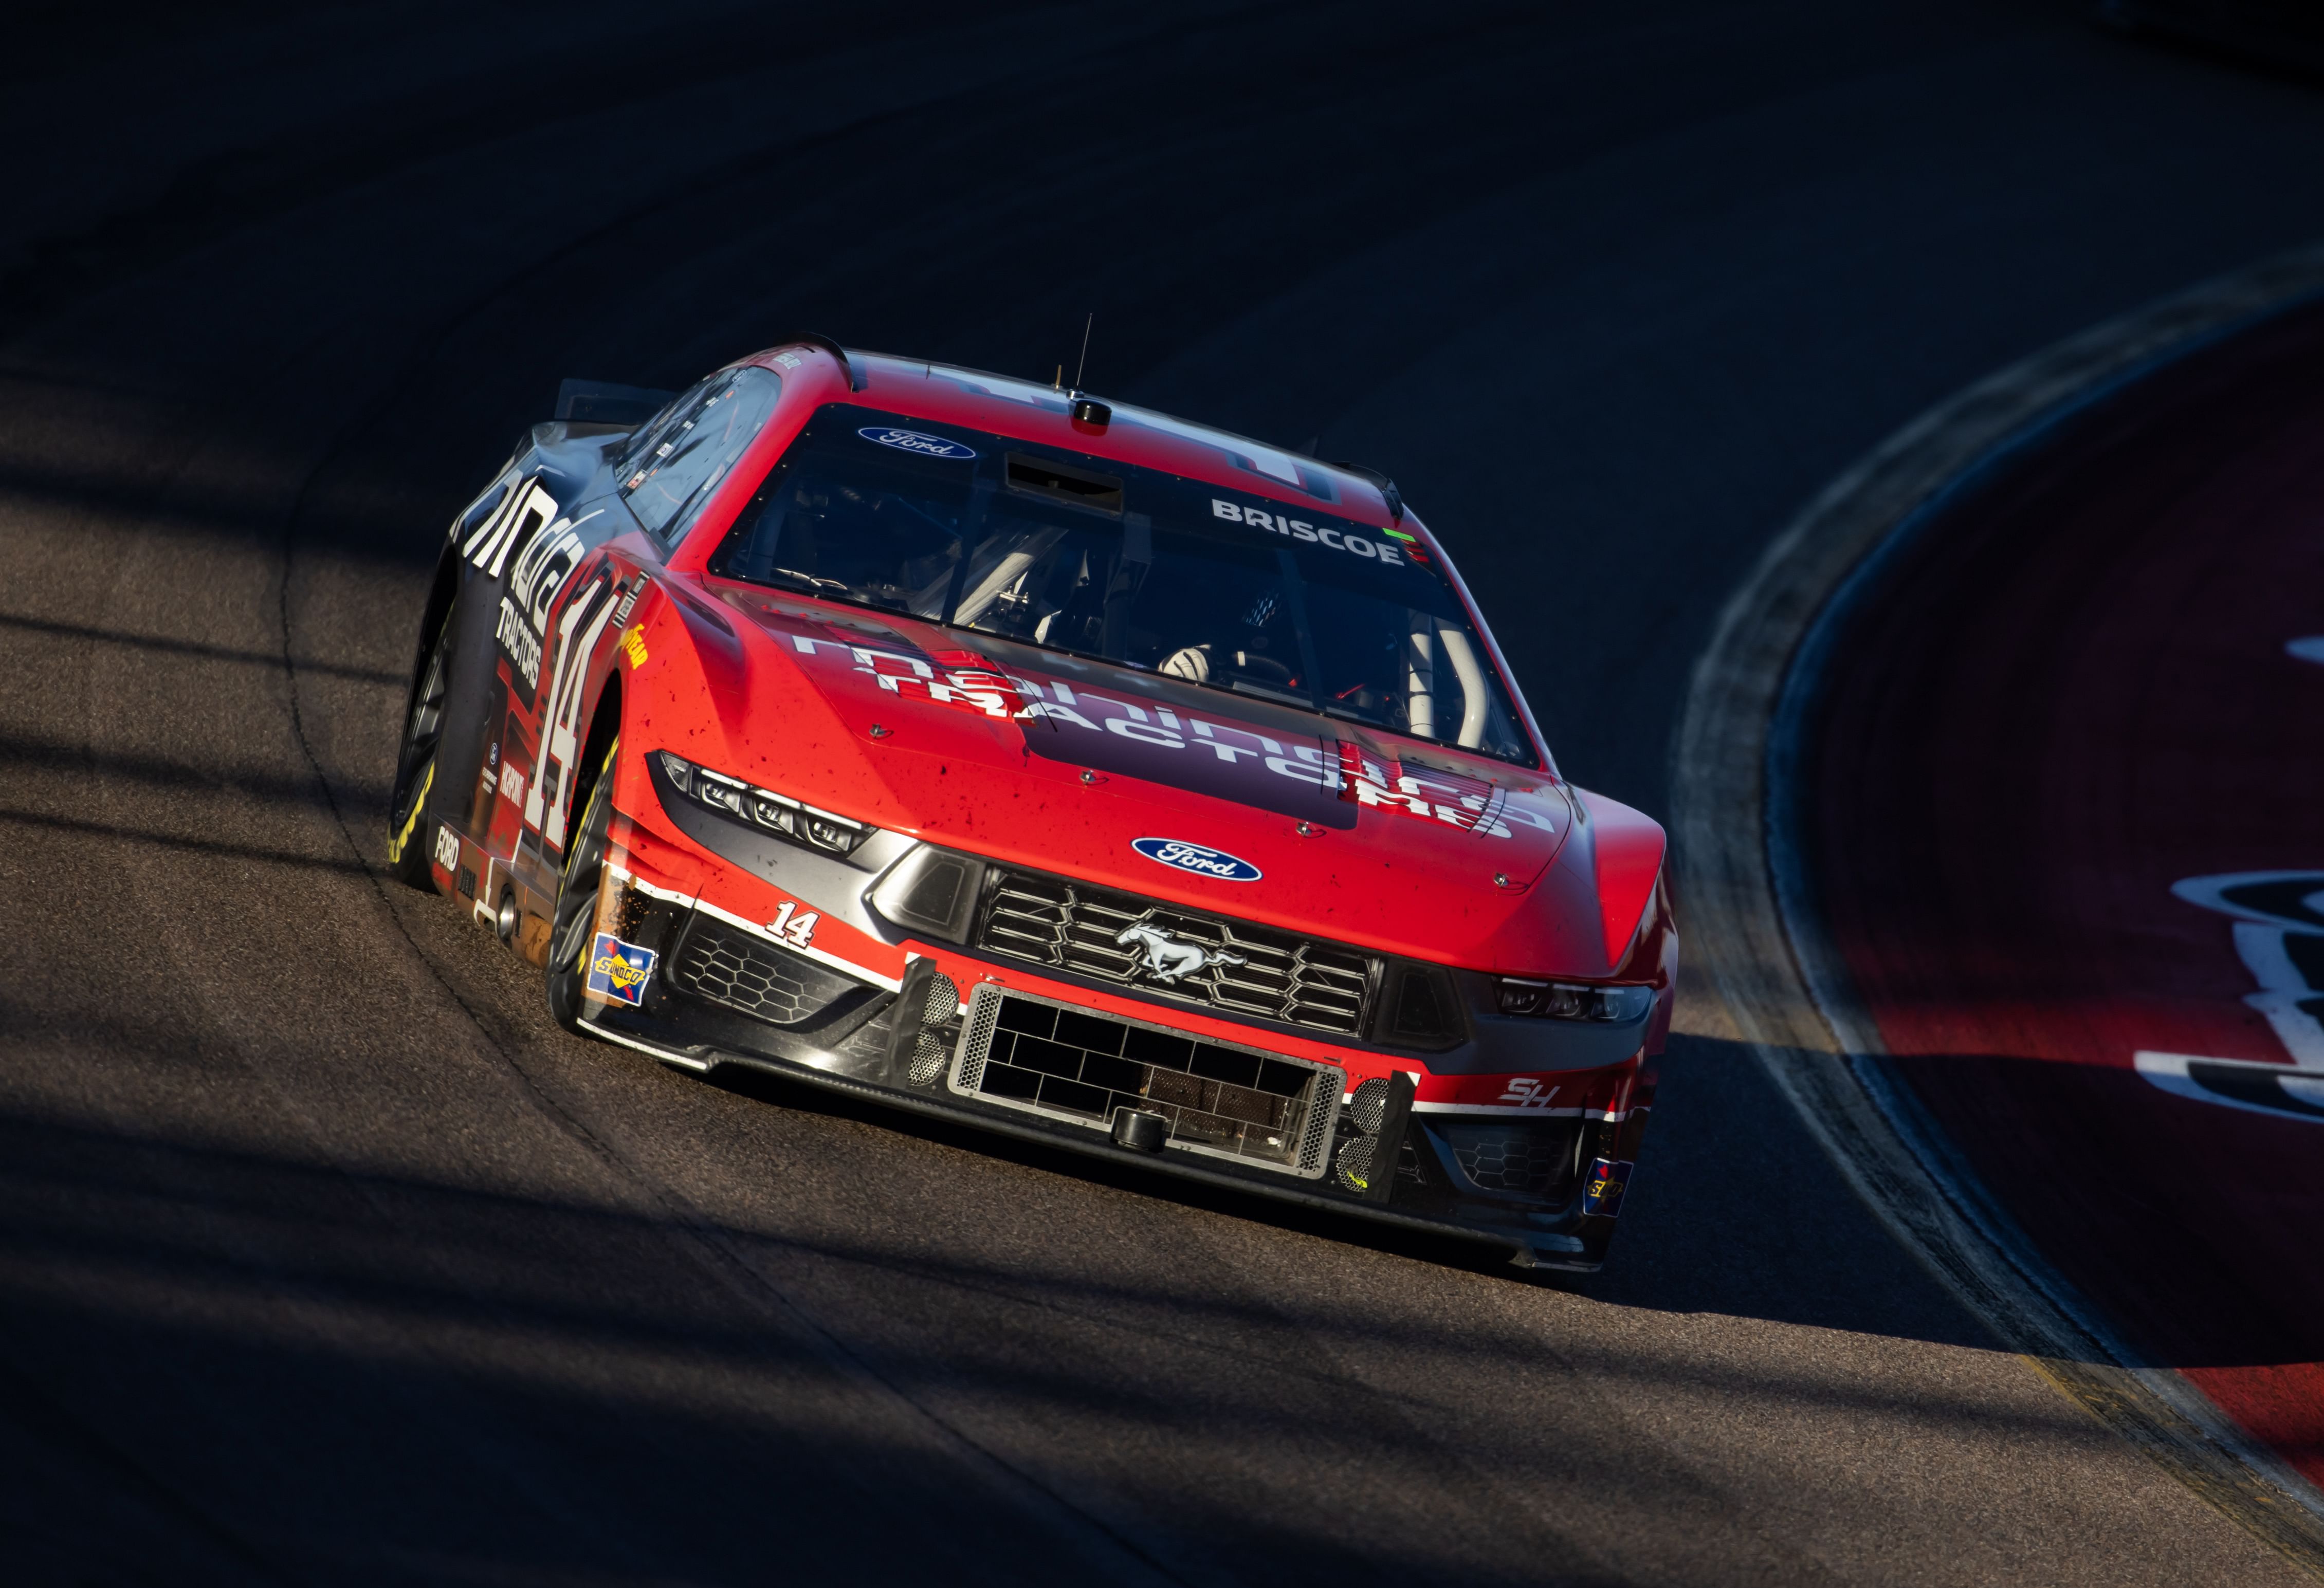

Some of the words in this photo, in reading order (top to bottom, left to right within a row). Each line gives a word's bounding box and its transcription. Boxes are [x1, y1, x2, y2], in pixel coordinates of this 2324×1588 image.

[879, 430, 956, 455] Ford
[1212, 498, 1405, 566] BRISCOE
[496, 596, 541, 690] TRACTORS
[524, 577, 620, 849] 14
[852, 667, 1513, 839] TRACTORS
[435, 825, 459, 872] FORD
[1156, 843, 1238, 876] Ford
[766, 900, 821, 950] 14
[598, 959, 642, 983] SUNOCO
